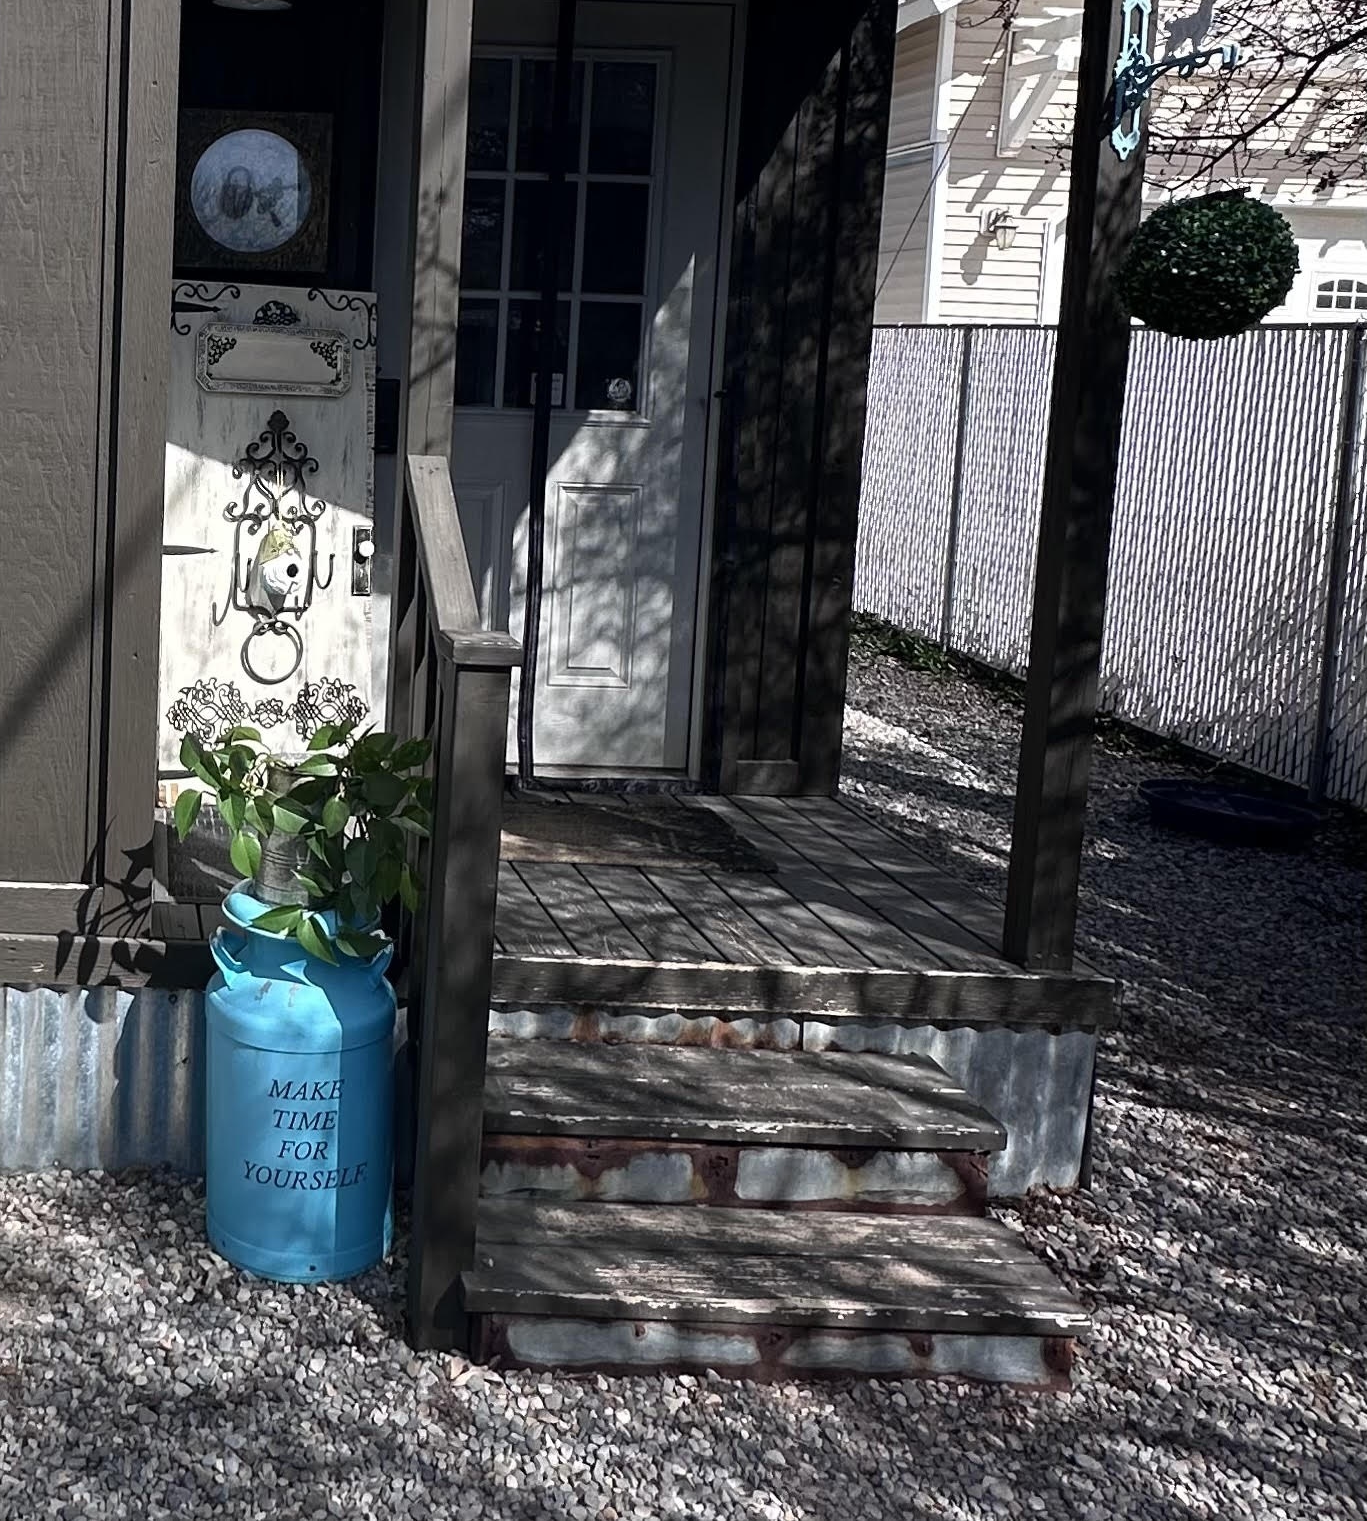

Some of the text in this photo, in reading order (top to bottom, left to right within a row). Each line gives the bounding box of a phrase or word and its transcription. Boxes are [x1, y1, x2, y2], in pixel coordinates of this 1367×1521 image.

[269, 1079, 345, 1100] MAKE
[273, 1109, 337, 1130] TIME
[277, 1140, 329, 1160] FOR
[244, 1160, 368, 1190] YOURSELF
